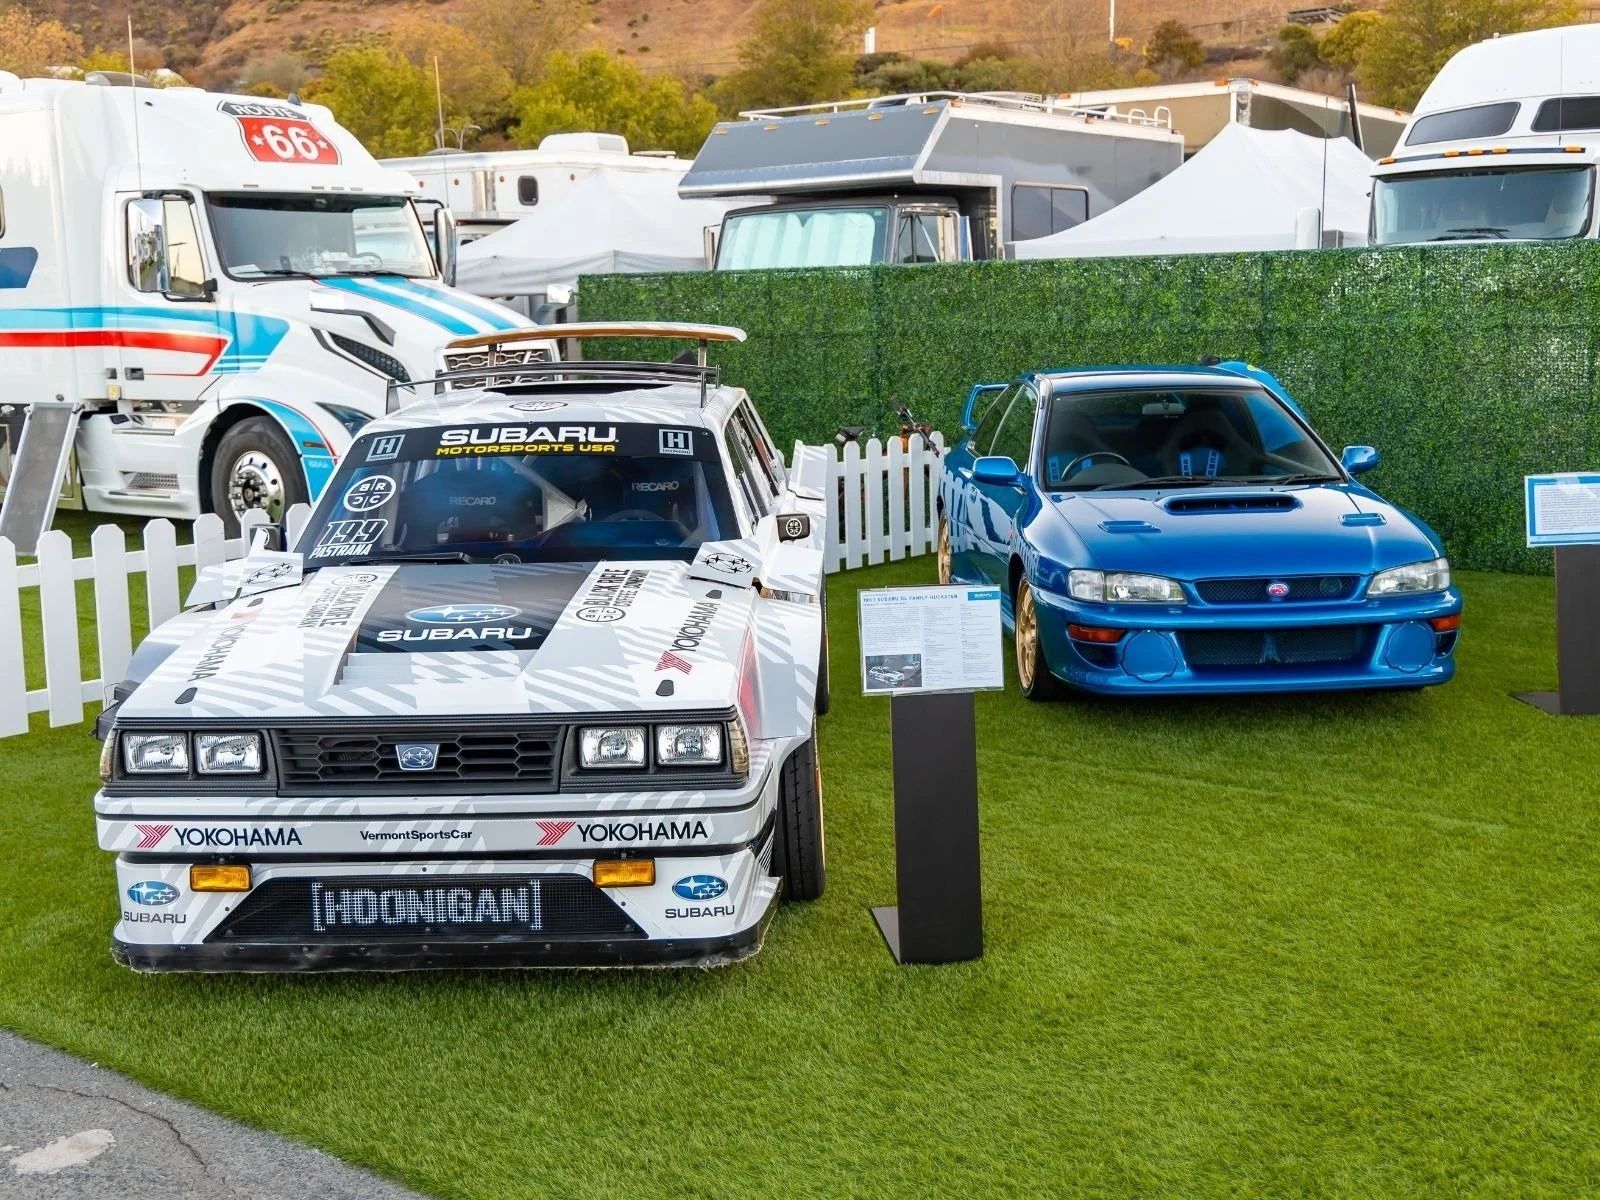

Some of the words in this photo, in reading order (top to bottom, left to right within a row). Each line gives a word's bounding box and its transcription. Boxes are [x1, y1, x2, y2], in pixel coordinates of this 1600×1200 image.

[230, 104, 298, 119] ROUTE
[262, 124, 319, 161] 66
[439, 427, 617, 445] SUBARU
[436, 444, 574, 456] MOTORSPORTS
[579, 444, 616, 453] USA
[632, 480, 680, 492] RECARO
[449, 496, 497, 506] RECARO
[317, 518, 389, 547] 199
[308, 543, 374, 560] PASTRANA
[377, 627, 533, 642] SUBARU
[669, 602, 721, 652] YOKOHAMA
[186, 621, 252, 682] YOKOHAMA
[174, 827, 303, 846] YOKOHAMA
[360, 829, 473, 842] VermontSportsCar
[577, 820, 709, 842] YOKOHAMA
[123, 910, 187, 924] SUBARU
[664, 904, 735, 919] SUBARU
